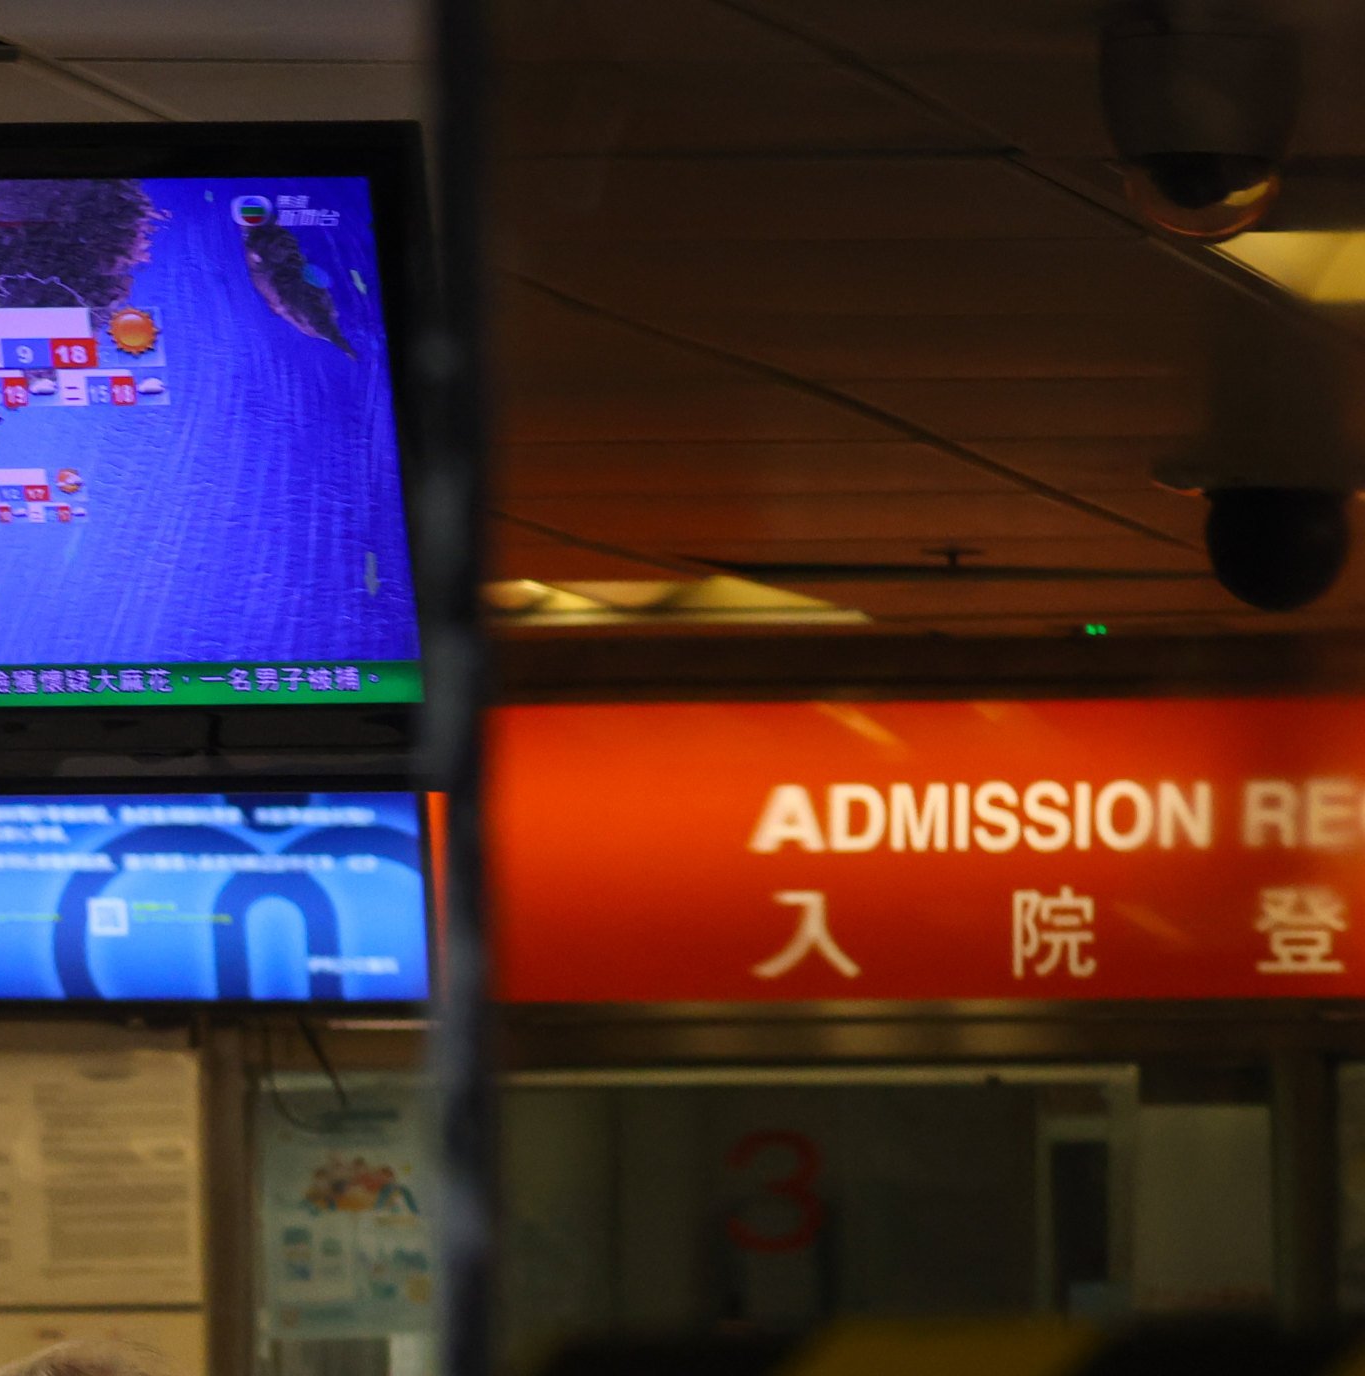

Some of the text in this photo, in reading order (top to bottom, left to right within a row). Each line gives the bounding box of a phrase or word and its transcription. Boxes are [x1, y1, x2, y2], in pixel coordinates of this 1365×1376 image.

[15, 345, 34, 364] 9
[54, 345, 89, 364] 18
[749, 777, 1365, 854] ADMISSION RE
[752, 882, 1348, 981] 入院登
[726, 1128, 826, 1253] 3
